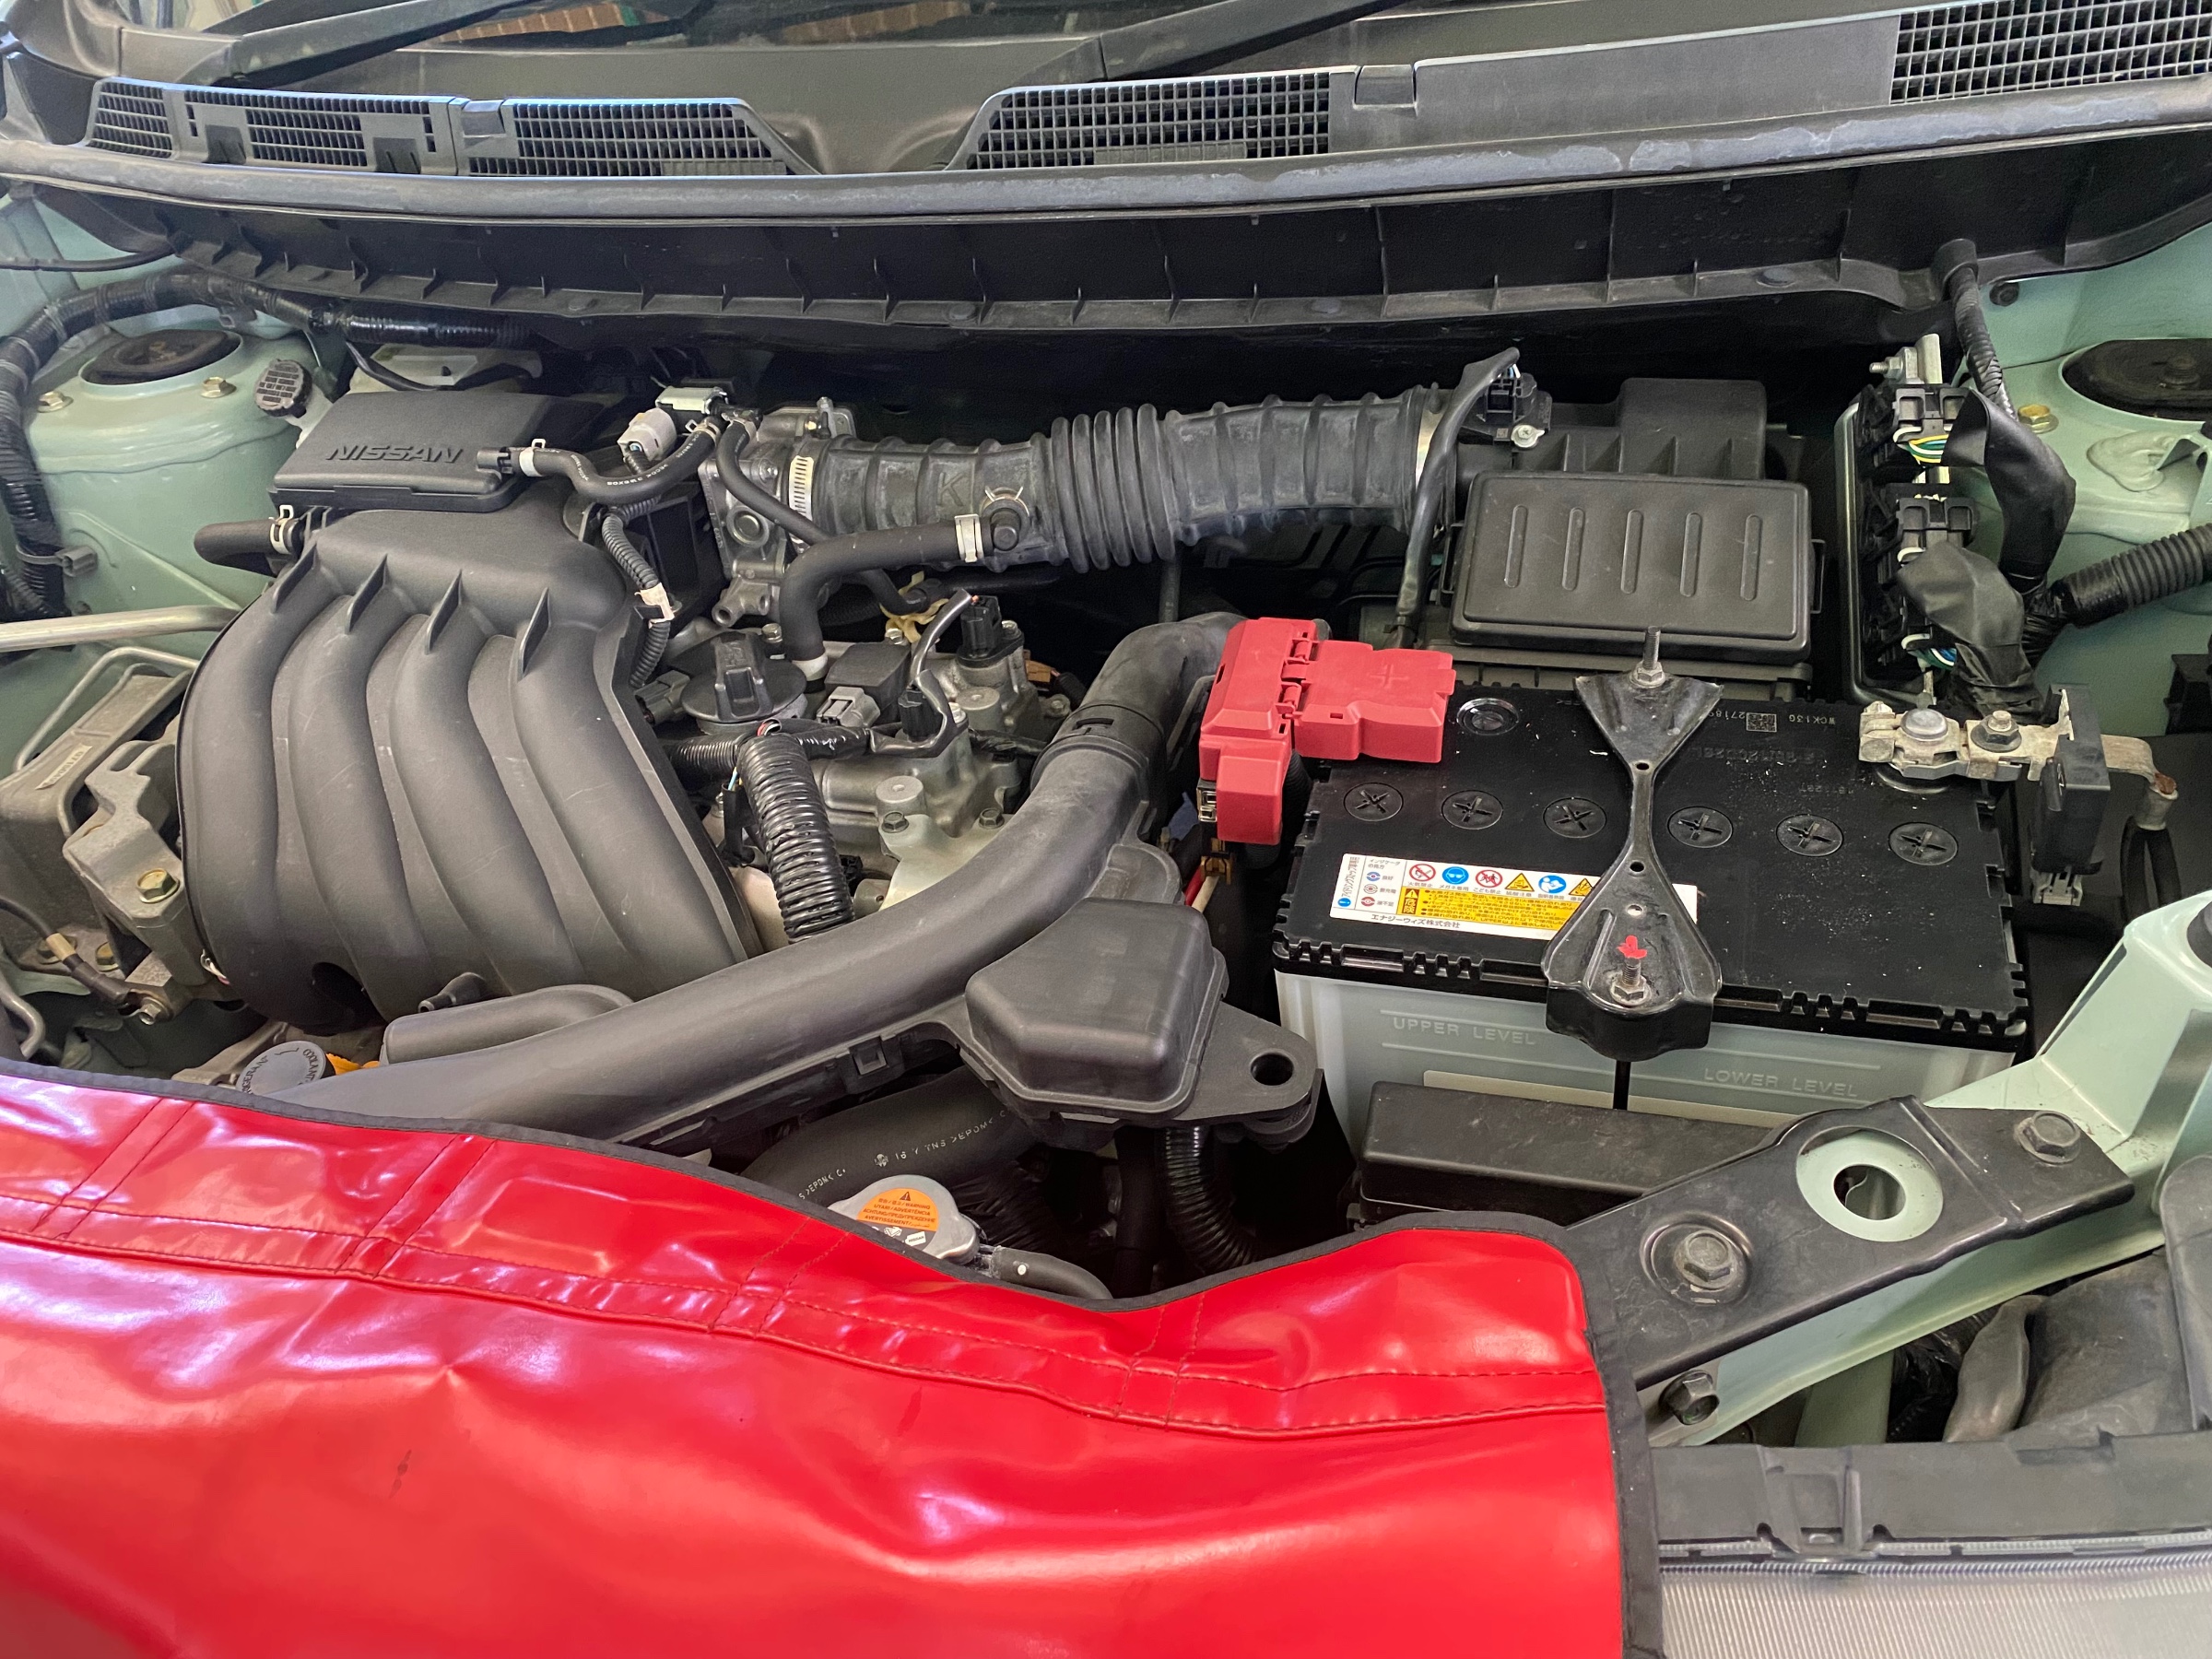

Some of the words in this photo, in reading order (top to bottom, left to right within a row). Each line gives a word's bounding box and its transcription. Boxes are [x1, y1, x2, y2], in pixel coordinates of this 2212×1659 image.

[324, 444, 464, 464] NISSAN
[937, 471, 968, 507] K
[1788, 713, 1836, 725] WCK13G
[1403, 899, 1418, 914] 危険
[1371, 913, 1461, 929] エナジーウィズ株式会社
[1393, 1017, 1460, 1037] UPPER
[1473, 1026, 1536, 1045] LEVEL
[1704, 1067, 1779, 1088] LOWER
[1791, 1077, 1858, 1098] LEVEL
[905, 1201, 931, 1210] WARNING
